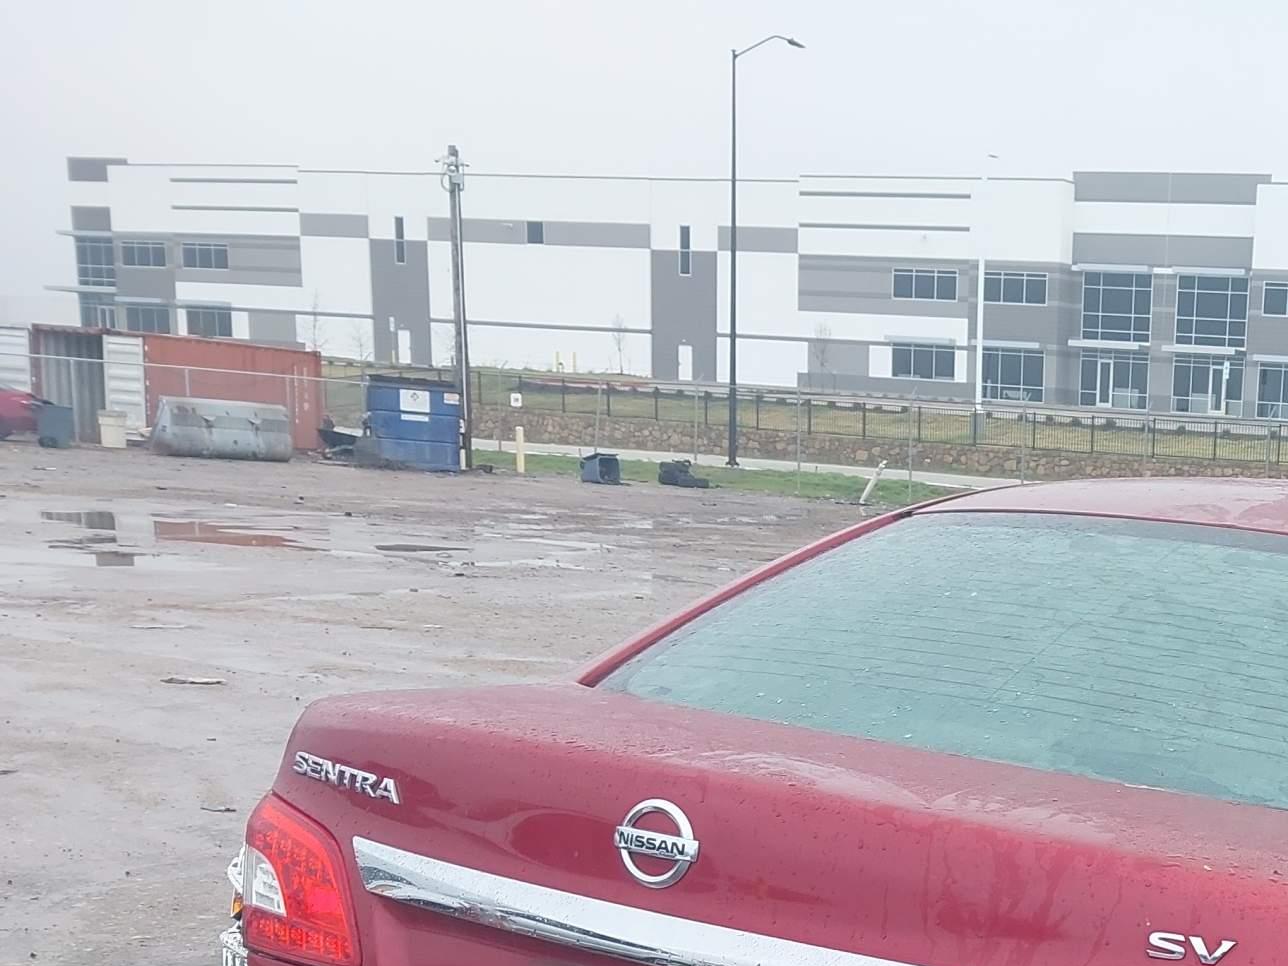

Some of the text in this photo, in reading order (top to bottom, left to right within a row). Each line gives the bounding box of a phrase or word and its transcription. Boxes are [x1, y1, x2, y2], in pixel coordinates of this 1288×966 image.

[293, 751, 400, 805] SENTRA
[618, 831, 685, 856] NISSAN
[1145, 931, 1238, 965] SV
